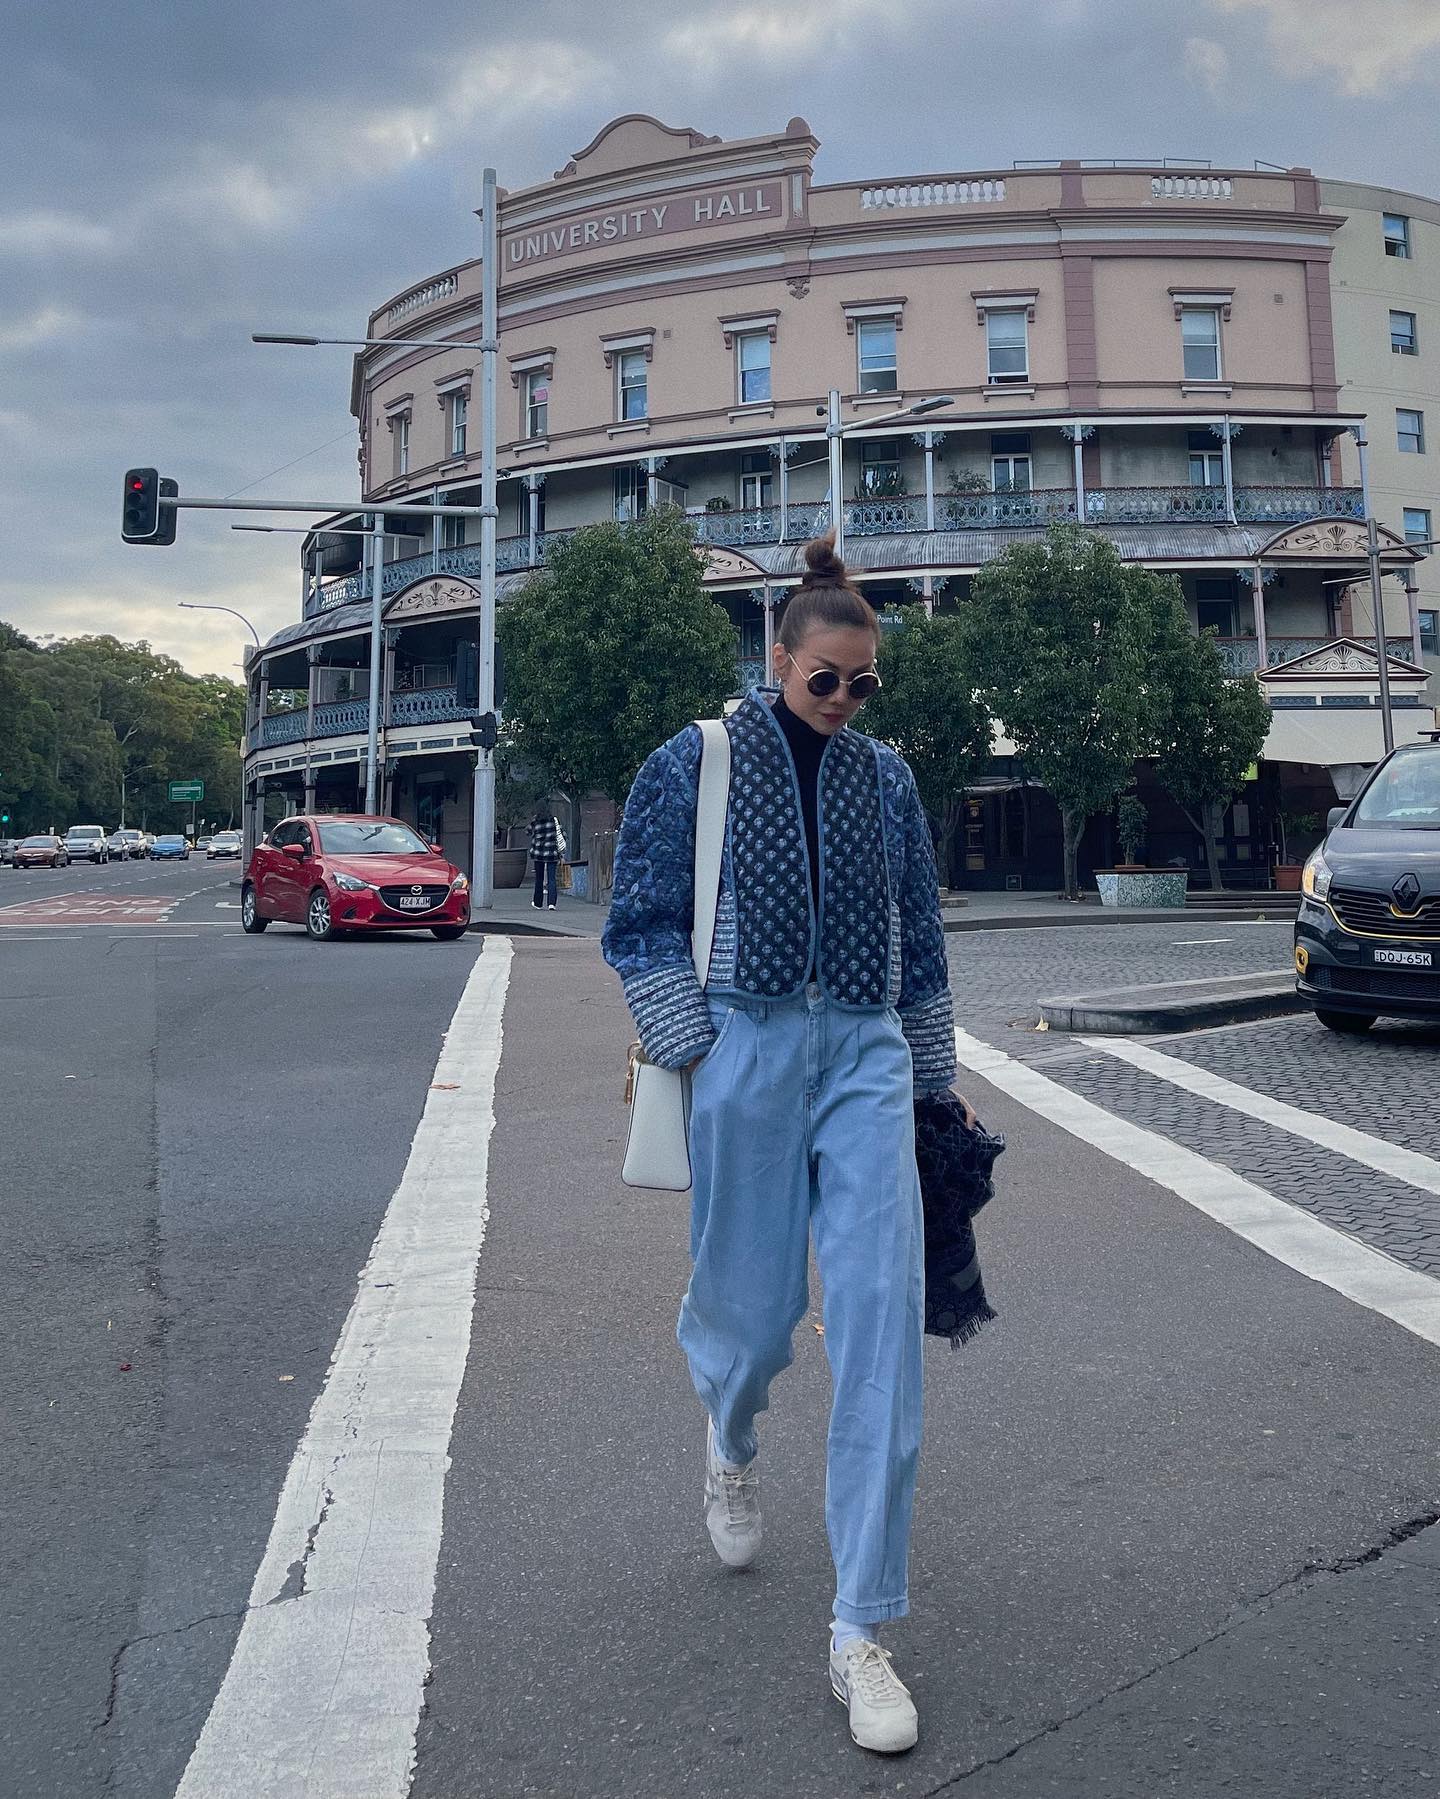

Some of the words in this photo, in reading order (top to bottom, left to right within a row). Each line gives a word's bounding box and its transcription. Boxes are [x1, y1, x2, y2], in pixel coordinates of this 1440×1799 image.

[510, 205, 668, 263] UNIVERSITY
[694, 190, 770, 222] HALL
[894, 615, 903, 624] Rd
